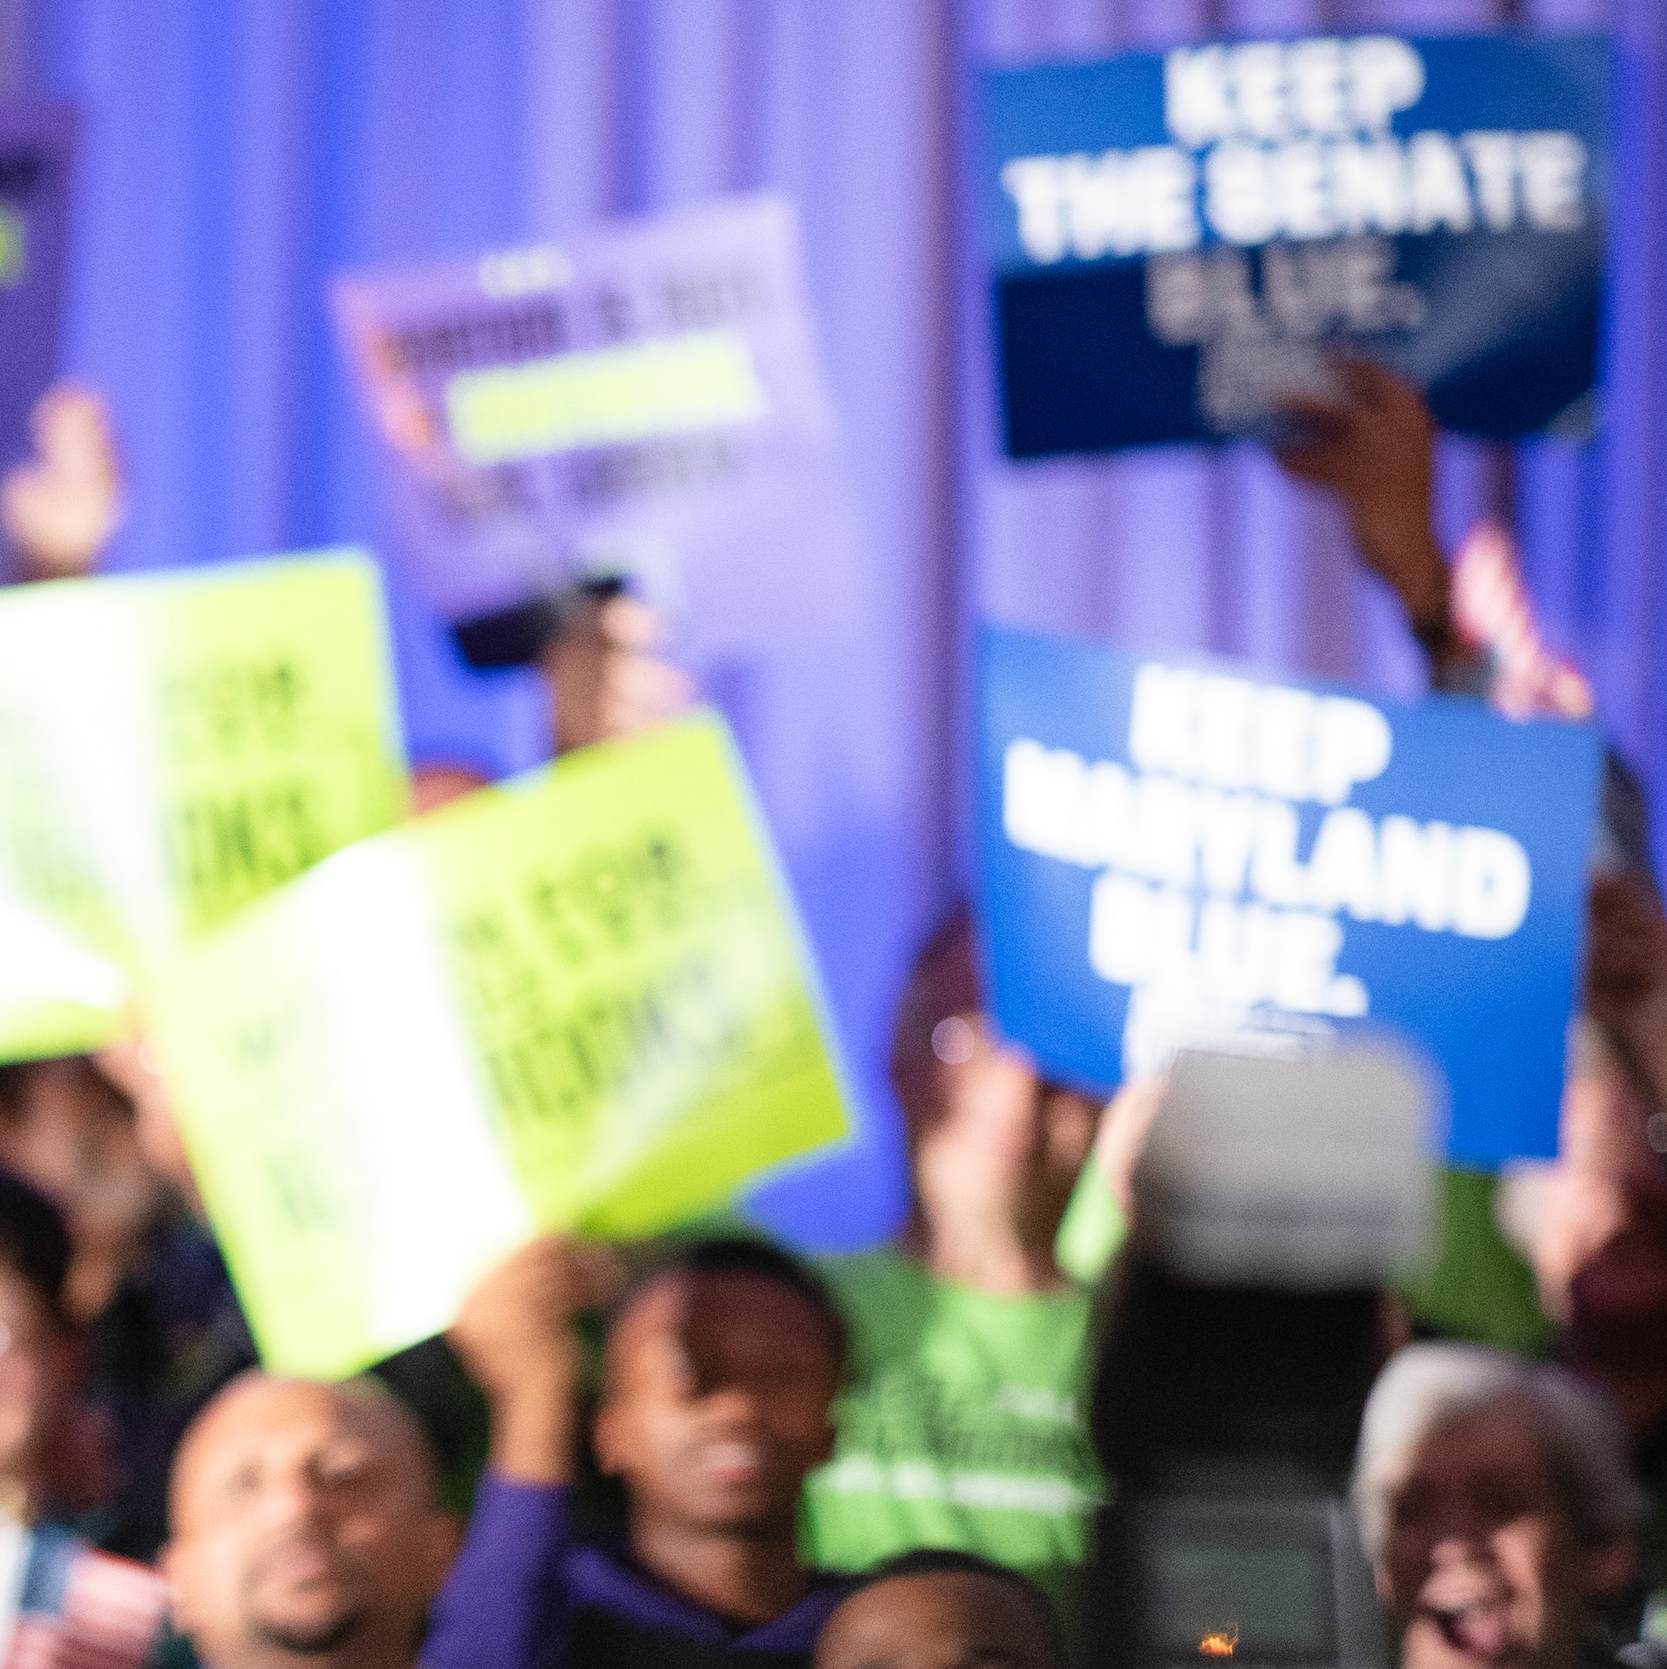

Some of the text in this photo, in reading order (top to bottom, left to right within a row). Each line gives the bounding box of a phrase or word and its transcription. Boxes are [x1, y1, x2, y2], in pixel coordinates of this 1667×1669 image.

[1164, 36, 1424, 144] KEEP
[1003, 131, 1586, 262] THE SENATE
[1146, 240, 1424, 344] BLUE.
[1131, 662, 1391, 803] KEEP
[1003, 739, 1530, 939] MARYLAND
[1090, 872, 1369, 1018] BLUE.
